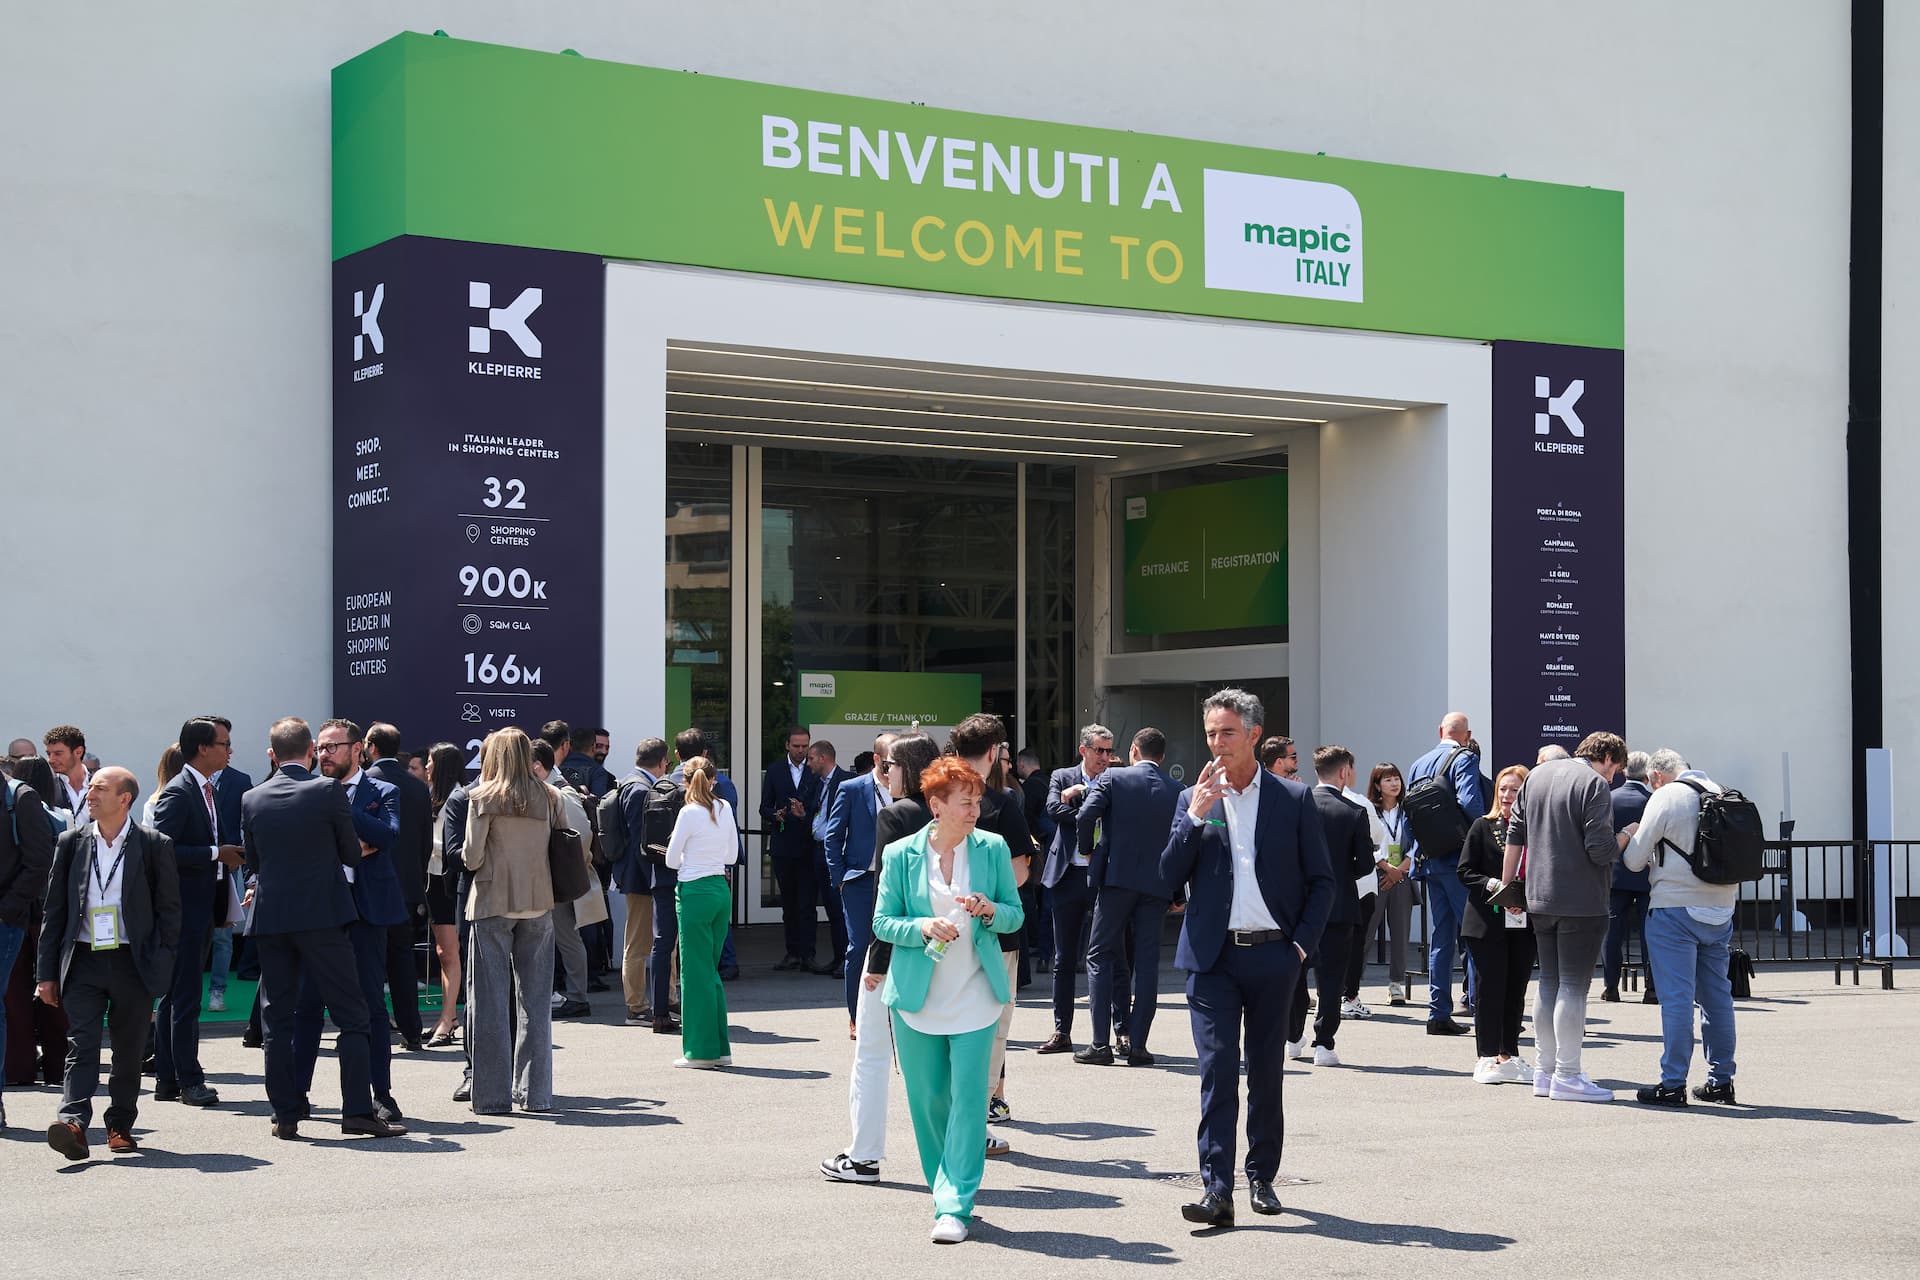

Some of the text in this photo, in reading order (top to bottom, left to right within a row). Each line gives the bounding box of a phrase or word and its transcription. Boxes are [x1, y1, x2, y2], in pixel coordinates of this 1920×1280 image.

[762, 115, 1183, 213] BENVENUTI A
[764, 198, 1184, 284] WELCOME TO
[1244, 222, 1351, 253] mapic
[1296, 258, 1351, 287] ITALY
[353, 362, 384, 382] KLEPIERRE
[468, 361, 542, 380] KLEPIERRE
[356, 436, 382, 457] SHOP.
[464, 434, 544, 448] ITALIAN LEADER
[1534, 441, 1585, 455] KLEPIERRE
[449, 443, 560, 460] IN SHOPPING CENTERS
[356, 462, 381, 482] MEET.
[347, 486, 390, 509] CONNECT.
[482, 476, 527, 510] 32
[1536, 508, 1582, 519] PORTA DI ROMA
[490, 525, 537, 537] SHOPPING
[490, 536, 530, 546] CENTERS
[1544, 540, 1575, 548] CAMPANIA
[1141, 551, 1281, 577] ENTRANCE REGISTRATION
[458, 565, 547, 600] 900K
[1557, 571, 1570, 579] GRU
[346, 590, 392, 611] EUROPEAN
[1546, 602, 1573, 610] ROMAEST
[346, 613, 391, 633] LEADER IN
[489, 620, 531, 631] SQM GLA
[347, 635, 390, 655] SHOPPING
[1539, 632, 1580, 641] NAVE DE VERO
[349, 658, 387, 676] CENTERS
[464, 652, 541, 685] 166M
[488, 708, 516, 718] VISITS
[844, 712, 878, 722] GRAZIE
[887, 713, 916, 722] THANK
[918, 714, 938, 722] YOU
[1542, 724, 1579, 733] GRANDEMILIA
